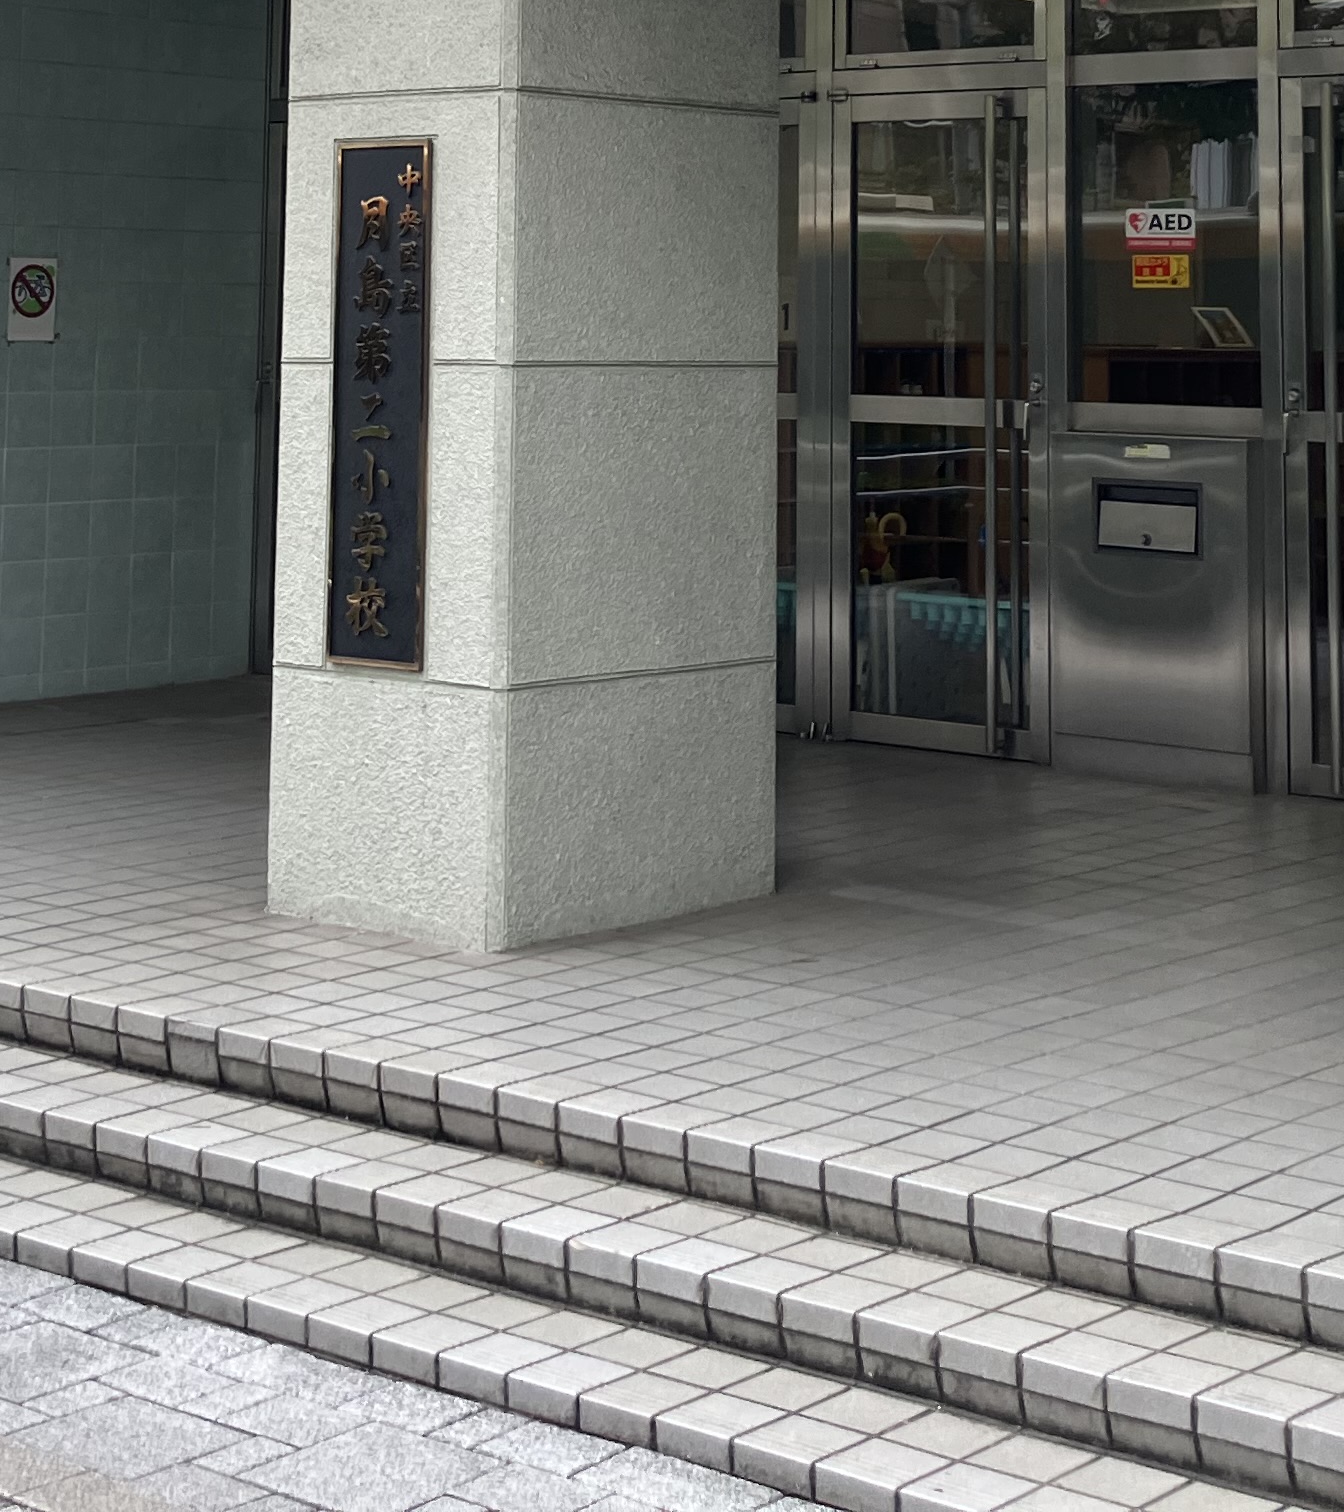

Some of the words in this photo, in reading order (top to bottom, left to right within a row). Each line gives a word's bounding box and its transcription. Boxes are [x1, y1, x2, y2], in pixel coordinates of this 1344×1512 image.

[396, 162, 423, 316] 中央区立
[1148, 213, 1193, 231] AED
[345, 195, 392, 638] 月島第二小学校
